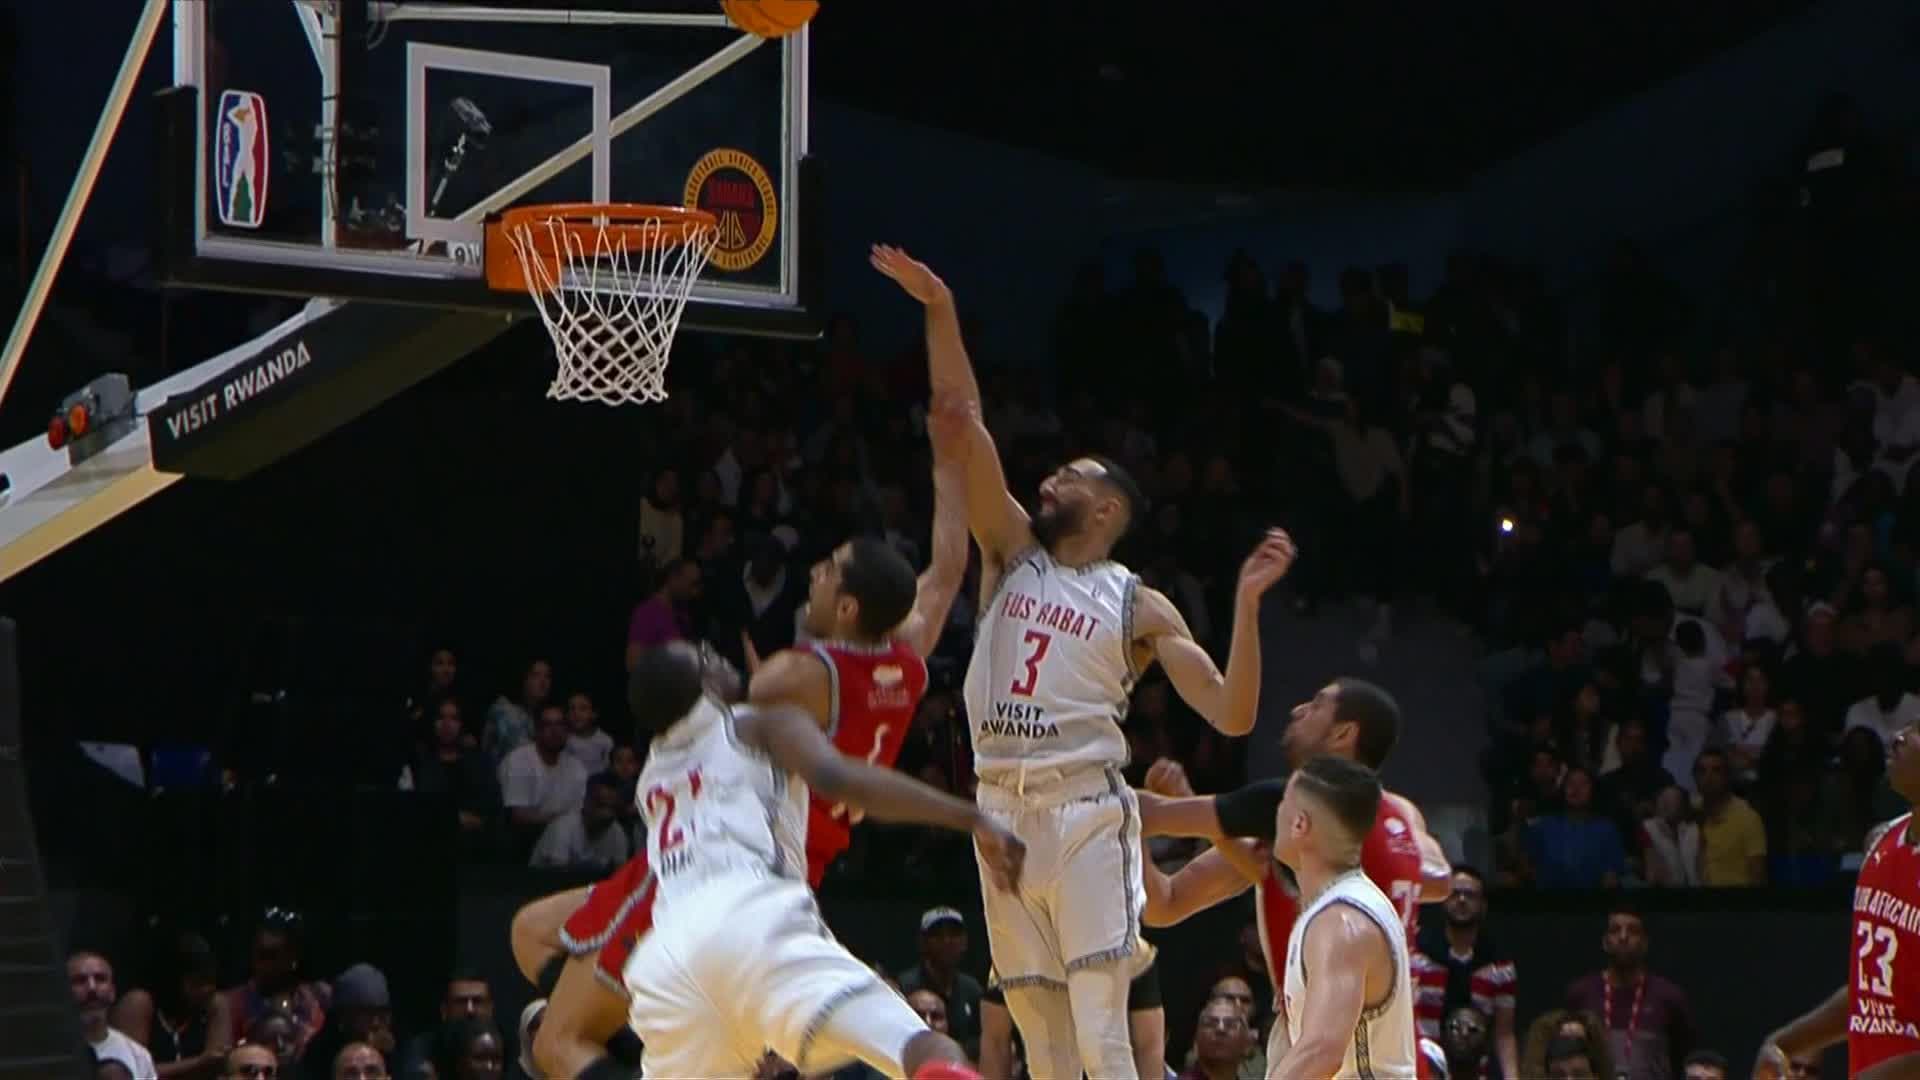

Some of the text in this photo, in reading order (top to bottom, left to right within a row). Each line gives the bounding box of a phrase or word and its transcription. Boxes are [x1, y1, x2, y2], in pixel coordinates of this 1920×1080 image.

[166, 340, 312, 441] VISIT RWANDA
[1001, 591, 1101, 641] FUS RABAT
[1010, 628, 1051, 697] 3
[996, 701, 1045, 722] VISIT
[1857, 920, 1898, 997] 23
